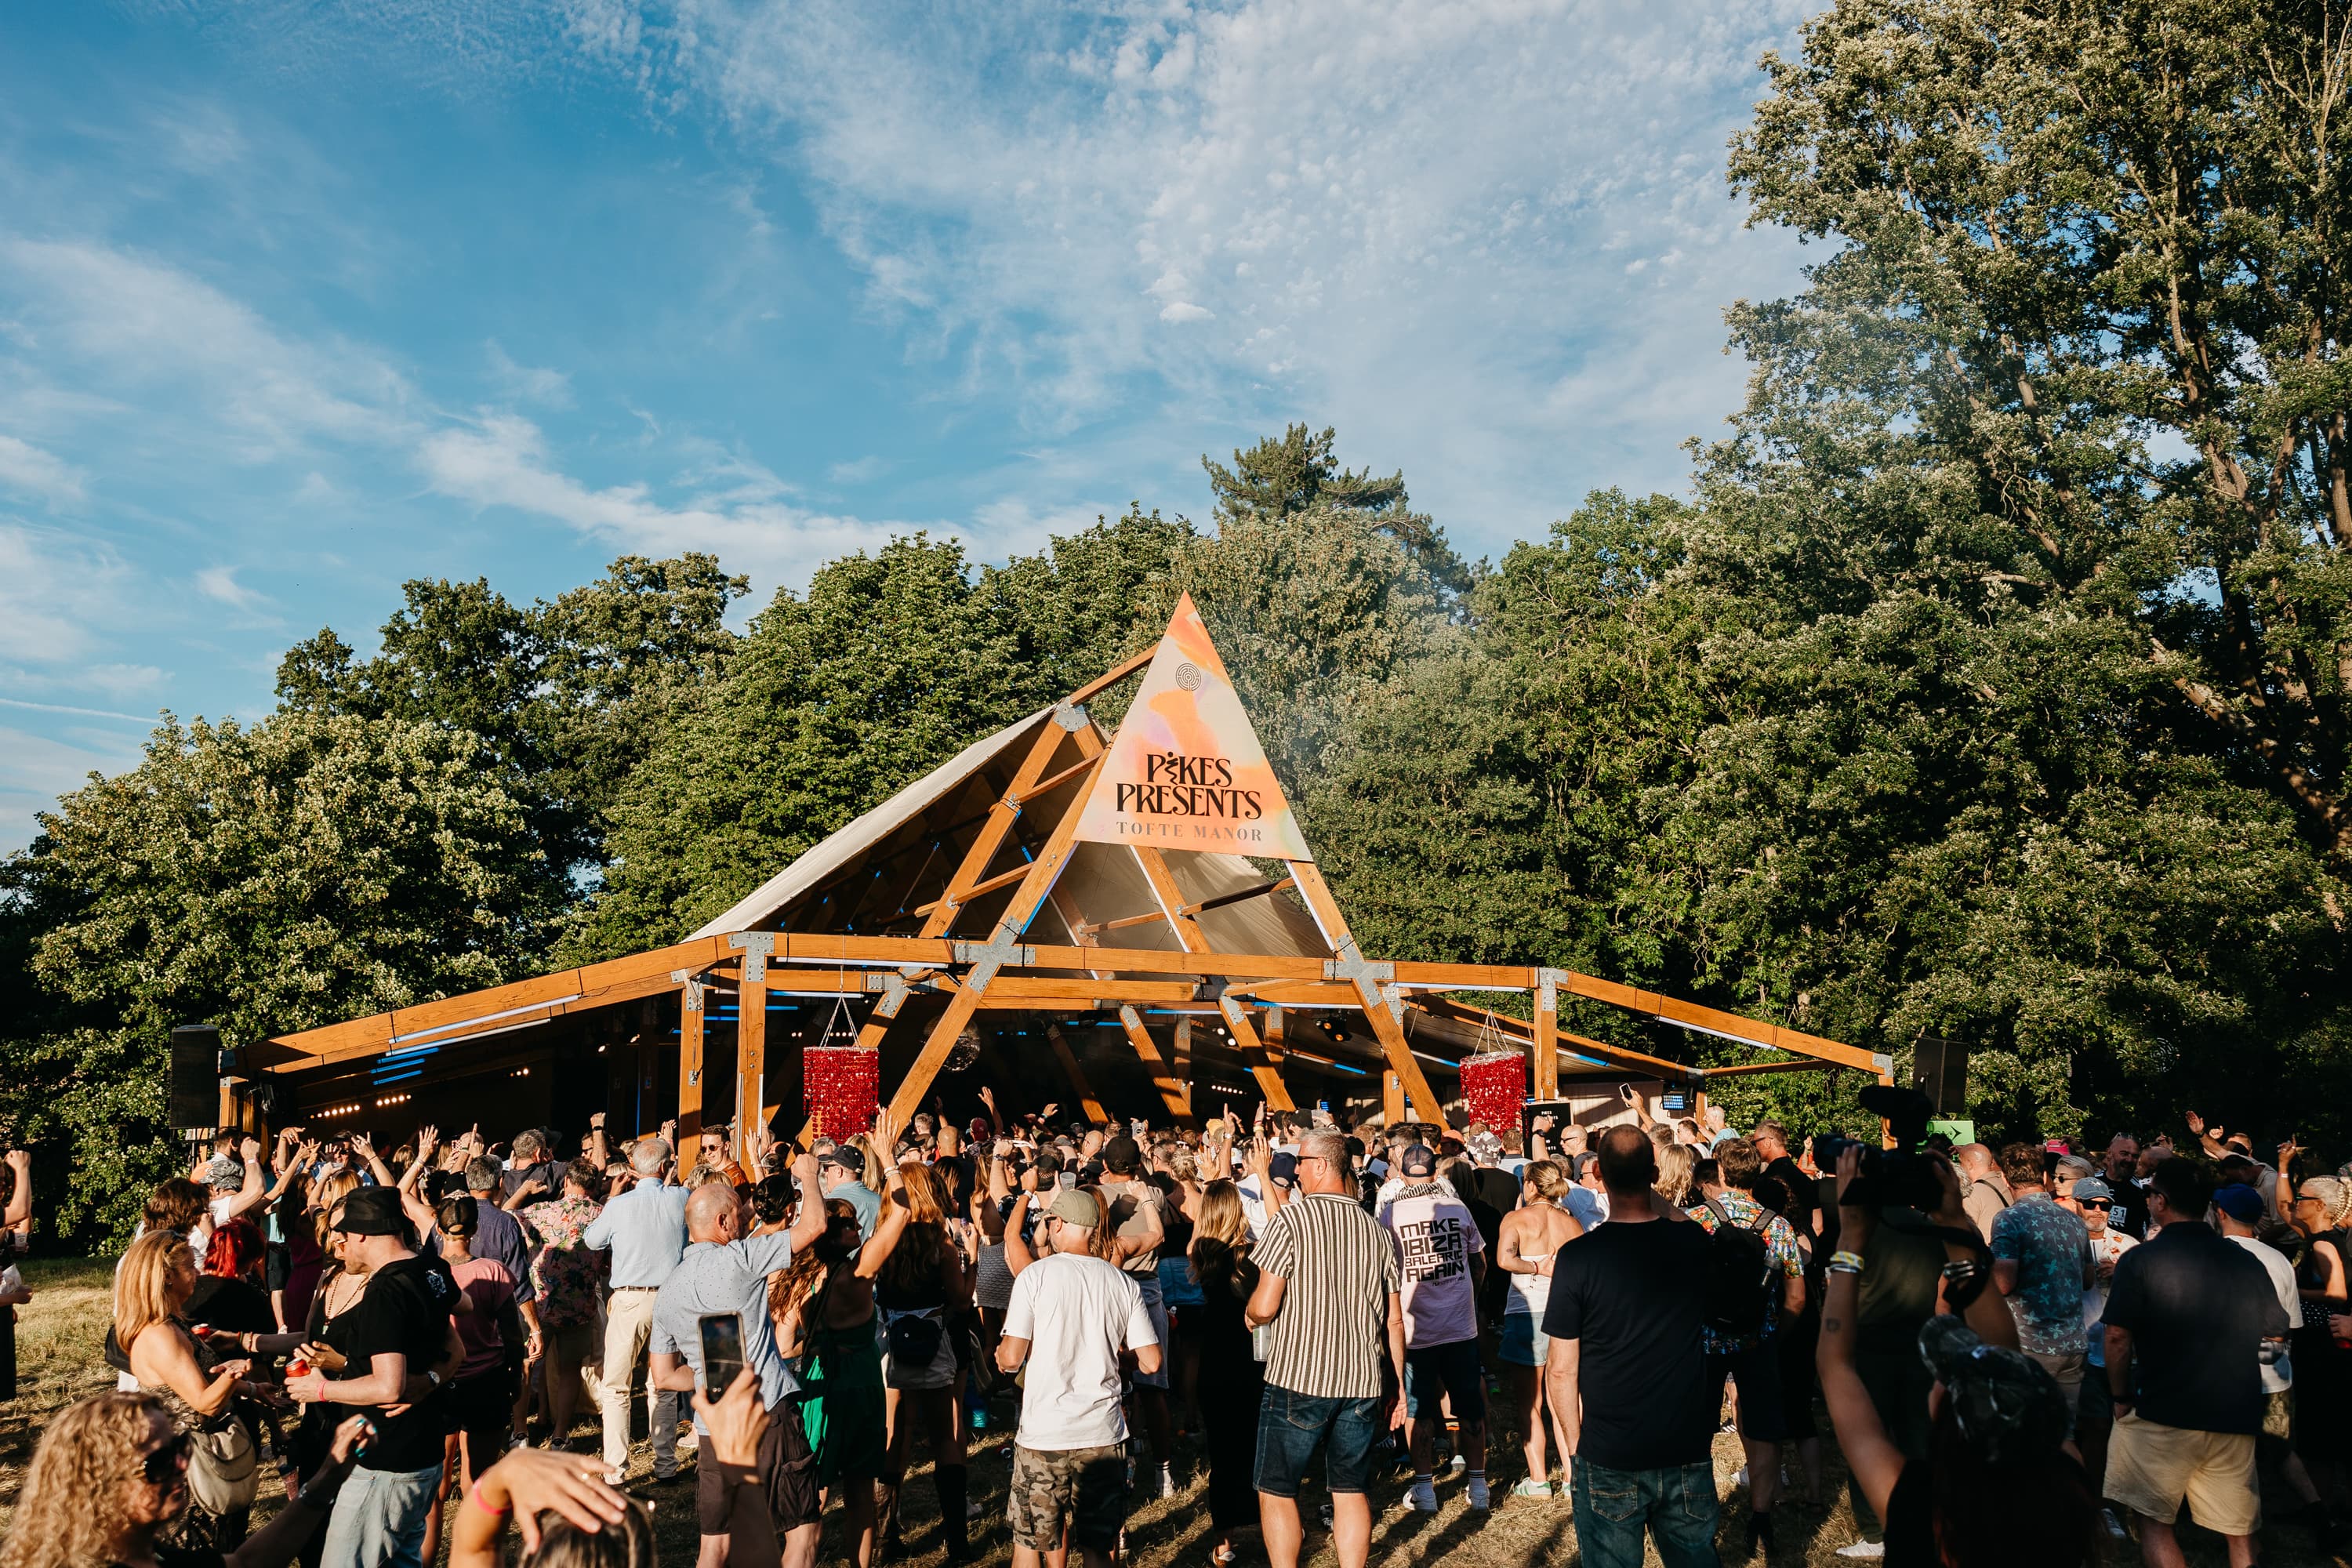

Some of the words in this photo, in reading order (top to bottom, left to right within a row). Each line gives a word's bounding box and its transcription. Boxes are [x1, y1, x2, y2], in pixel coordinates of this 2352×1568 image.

[1116, 782, 1262, 820] PRESENTS
[1116, 821, 1184, 837] TOFTE
[1193, 825, 1262, 841] MANOR
[1399, 1218, 1461, 1239] MAKE
[1403, 1232, 1463, 1257] IBIZA
[1405, 1249, 1463, 1267] BALEARIC
[1406, 1260, 1465, 1283] AGAIN
